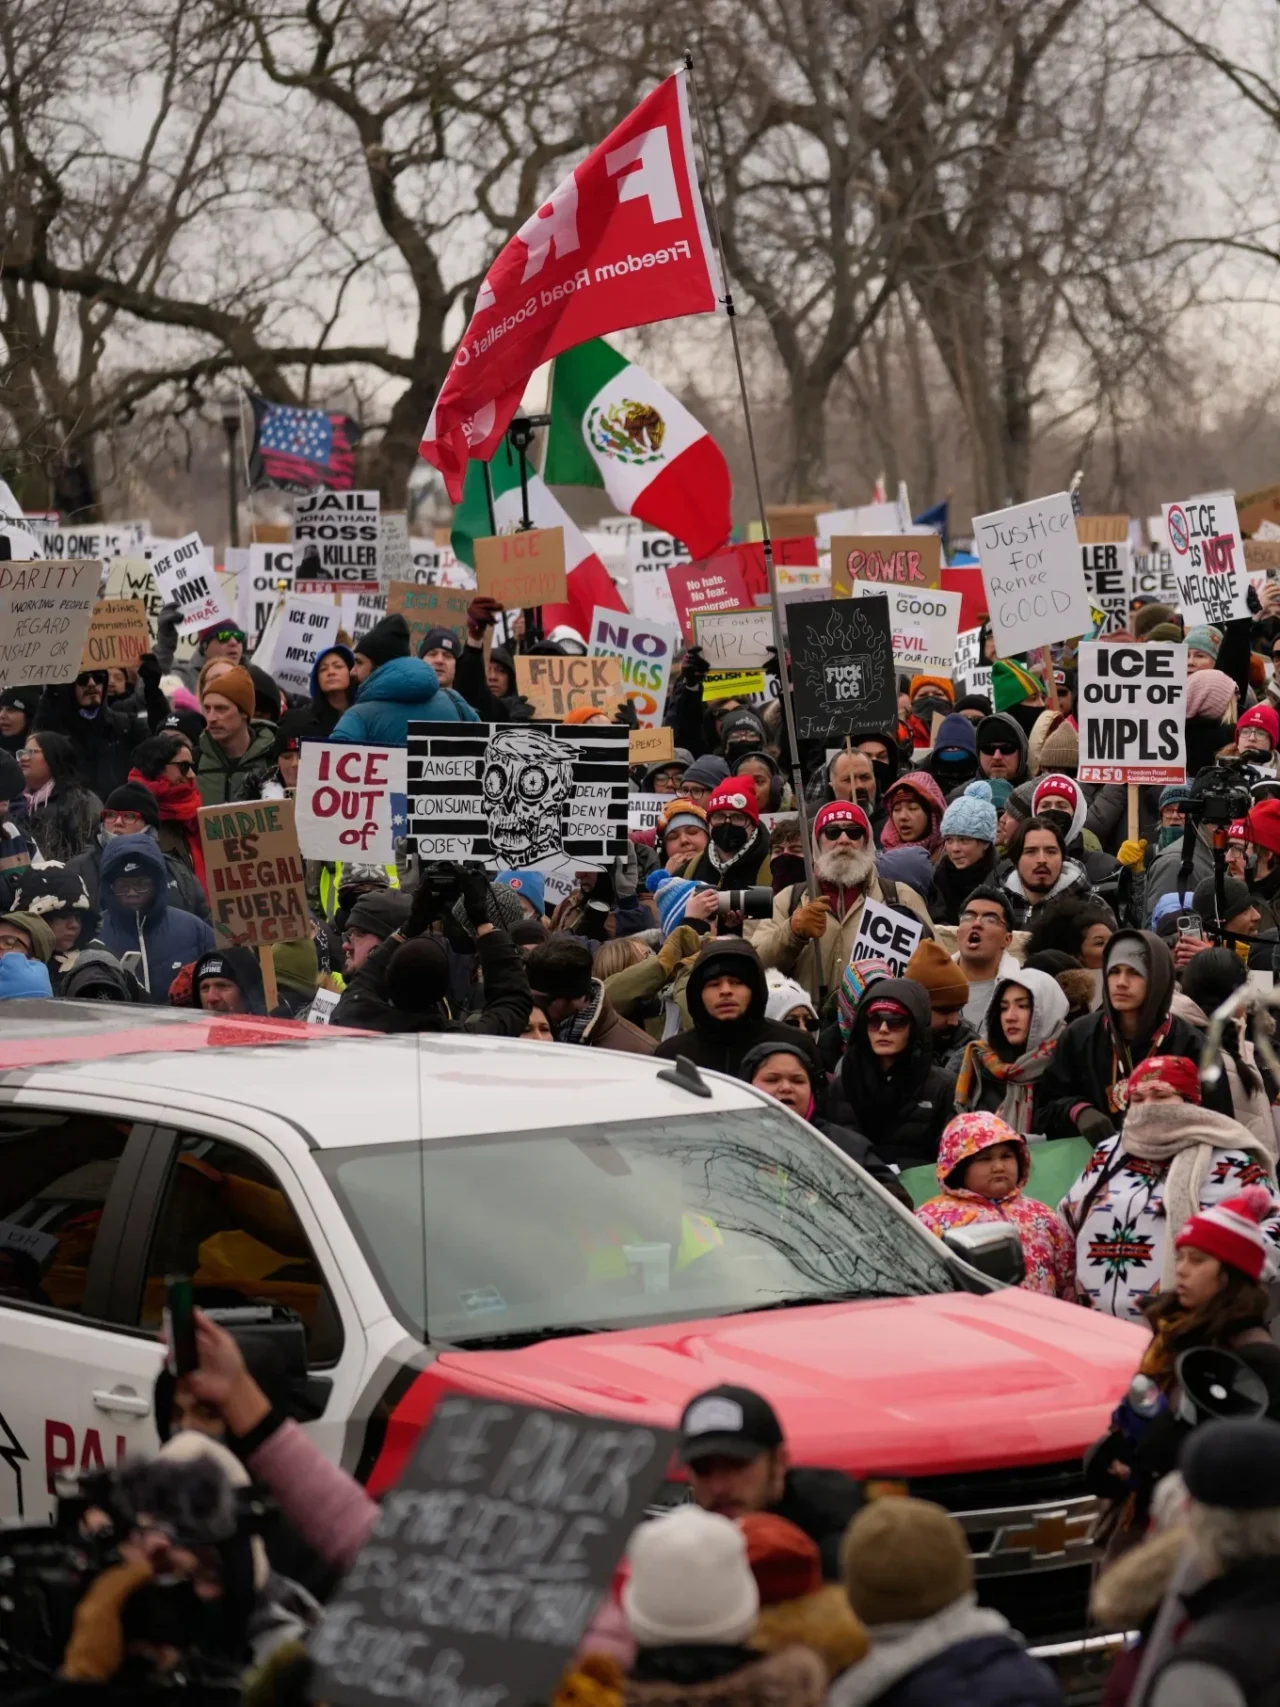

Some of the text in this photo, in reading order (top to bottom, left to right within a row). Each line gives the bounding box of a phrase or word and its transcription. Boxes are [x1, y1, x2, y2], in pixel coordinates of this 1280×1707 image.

[296, 494, 377, 513] JAIL
[295, 514, 377, 524] JONATHAN
[1185, 504, 1216, 537] ICE
[295, 525, 378, 541] ROSS
[982, 512, 1071, 550] Justice
[67, 535, 100, 556] ONE
[323, 545, 377, 566] KILLER
[642, 538, 690, 559] ICE
[1188, 533, 1236, 575] IS NOT
[154, 540, 200, 577] ICE OUT
[264, 551, 293, 572] IC
[847, 549, 927, 582] POWER
[1009, 549, 1045, 572] For
[1082, 545, 1118, 571] LER
[175, 566, 188, 581] OF
[334, 568, 378, 581] ICE
[686, 575, 727, 591] No hate.
[990, 571, 1048, 597] Renee
[1132, 574, 1177, 594] ICE
[170, 575, 211, 606] MN!
[691, 587, 728, 602] No fear.
[1177, 571, 1240, 606] WELCOME
[11, 600, 91, 614] WORKING PEOPLE
[183, 605, 220, 626] MIRAC
[896, 599, 947, 617] GOOD
[999, 589, 1071, 629] GOOD
[1204, 600, 1234, 622] HERE
[14, 617, 71, 639] REGARD
[88, 619, 144, 632] ommunities
[289, 610, 306, 625] ICE
[308, 613, 330, 629] OUT
[699, 617, 725, 628] ICE
[302, 632, 314, 644] OF
[596, 620, 668, 658] NO
[701, 631, 771, 660] MPLS
[892, 634, 929, 651] EVIL
[50, 641, 69, 657] OR
[89, 635, 148, 663] OUT NOW
[285, 646, 316, 664] MPLS
[904, 652, 922, 662] OUR
[924, 655, 953, 667] CITIES
[955, 648, 971, 663] LA
[20, 664, 73, 680] STATUS
[528, 658, 610, 688] FUCK
[825, 664, 862, 683] FUCK
[1097, 648, 1174, 678] ICE
[278, 671, 310, 687] MIRA
[972, 672, 993, 686] JUS
[552, 688, 608, 715] ICE
[1084, 683, 1183, 705] OUT OF
[800, 714, 896, 738] Fuck Trump!
[1087, 718, 1179, 761] MPLS
[318, 751, 389, 786] ICE
[423, 760, 475, 777] ANGER
[576, 785, 612, 799] DELAY
[311, 786, 385, 820] OUT
[415, 798, 481, 815] CONSUME
[572, 804, 607, 817] DENY
[204, 805, 284, 841] NADIE
[568, 822, 616, 838] DEPOSE
[339, 822, 379, 851] of
[417, 838, 474, 853] OBEY
[223, 833, 260, 863] ES
[213, 856, 304, 892] ILEGAL
[545, 876, 573, 896] MIRA
[217, 887, 301, 925] FUERA
[860, 909, 916, 958] ICE
[45, 1418, 127, 1497] PA
